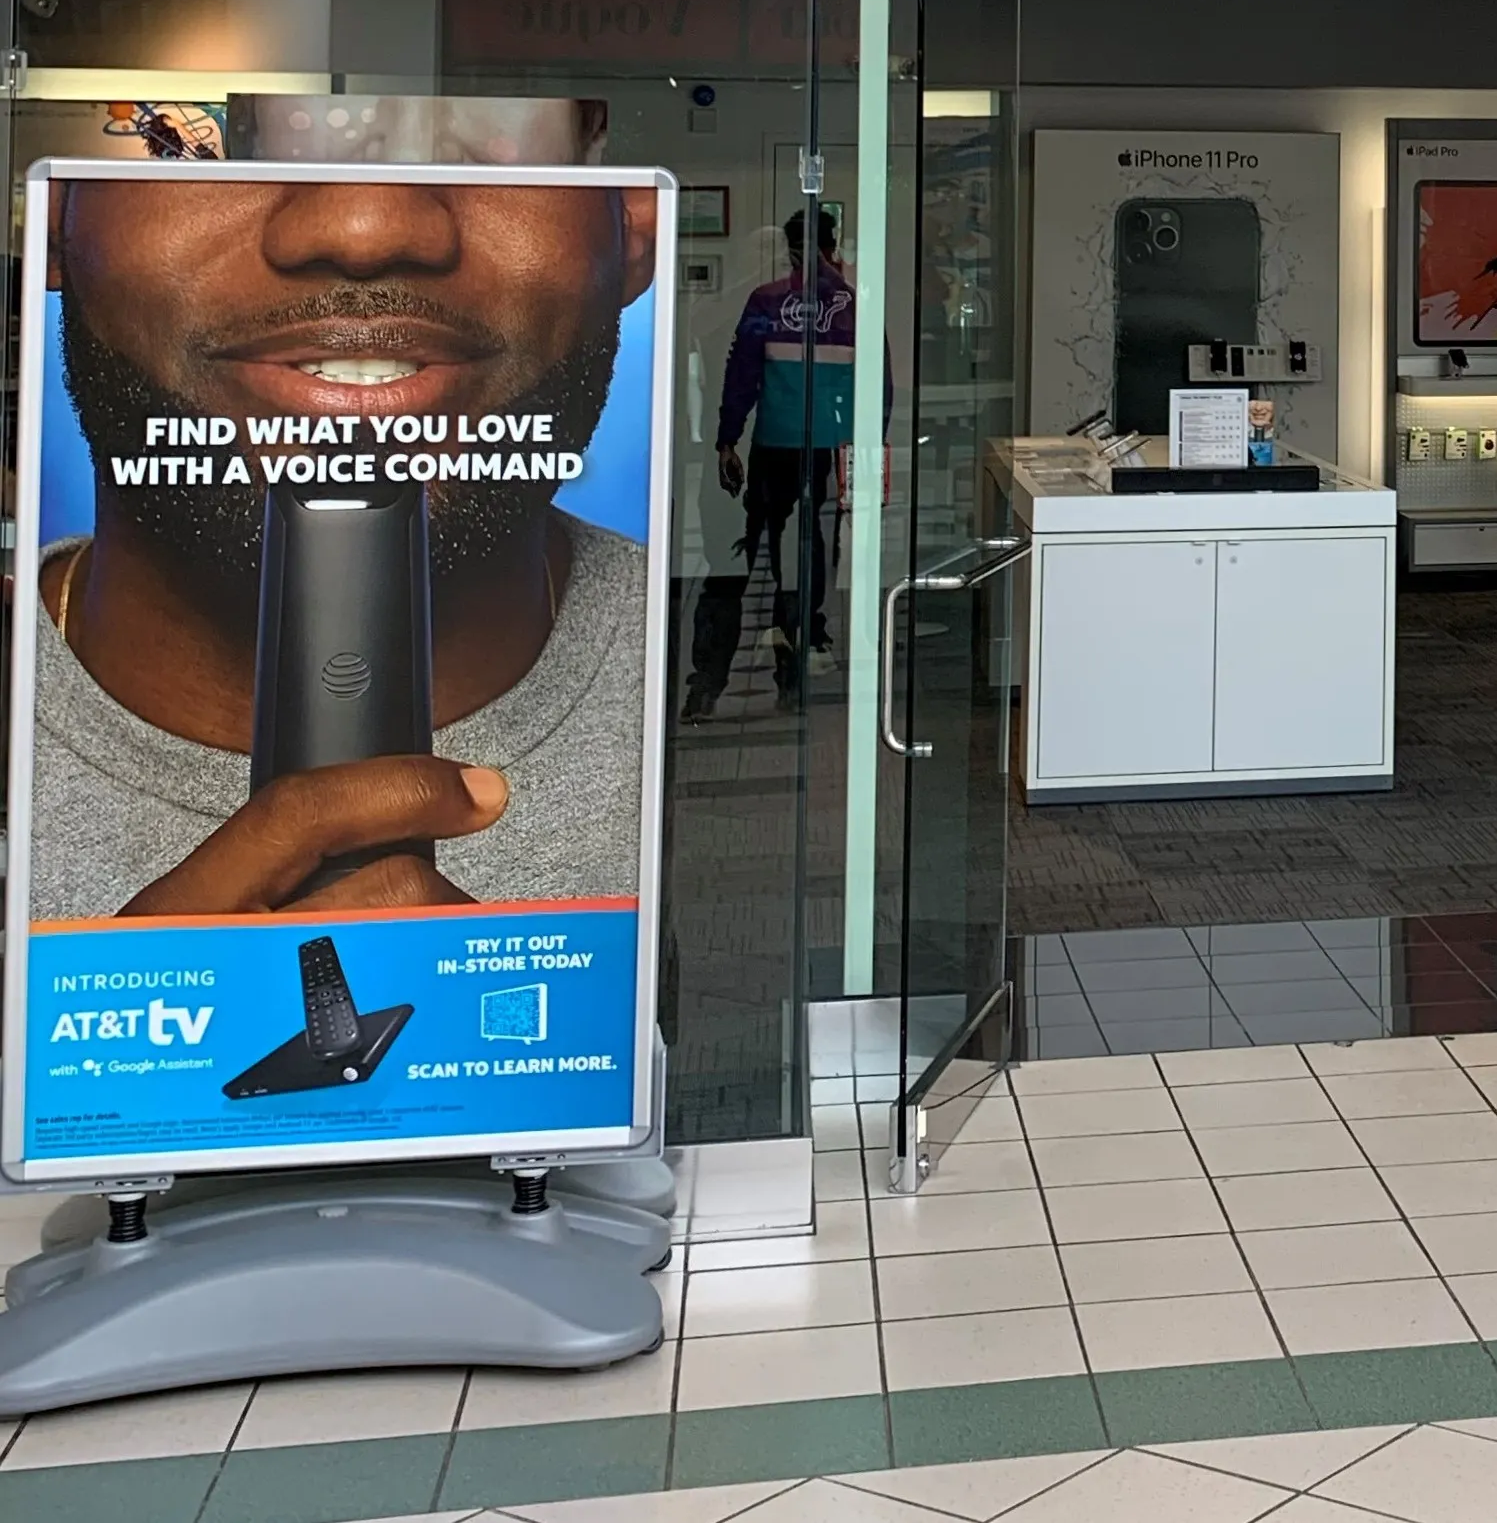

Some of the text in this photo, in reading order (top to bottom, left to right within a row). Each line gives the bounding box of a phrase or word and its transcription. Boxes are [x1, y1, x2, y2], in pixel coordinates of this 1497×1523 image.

[1133, 149, 1259, 172] iPhone 11 Pro
[1415, 145, 1459, 158] iPad Pro
[145, 413, 554, 447] FIND WHAT YOU LOVE
[111, 451, 584, 487] WITH A VOICE COMMAND
[465, 936, 568, 955] TRY IT OUT
[437, 953, 593, 974] IN-STORE TODAY
[53, 969, 216, 994] INTRODUCING
[50, 998, 215, 1045] AT&T tv
[49, 1056, 214, 1077] with Google Assistant
[407, 1055, 618, 1080] SCAN TO LEARN MORE.
